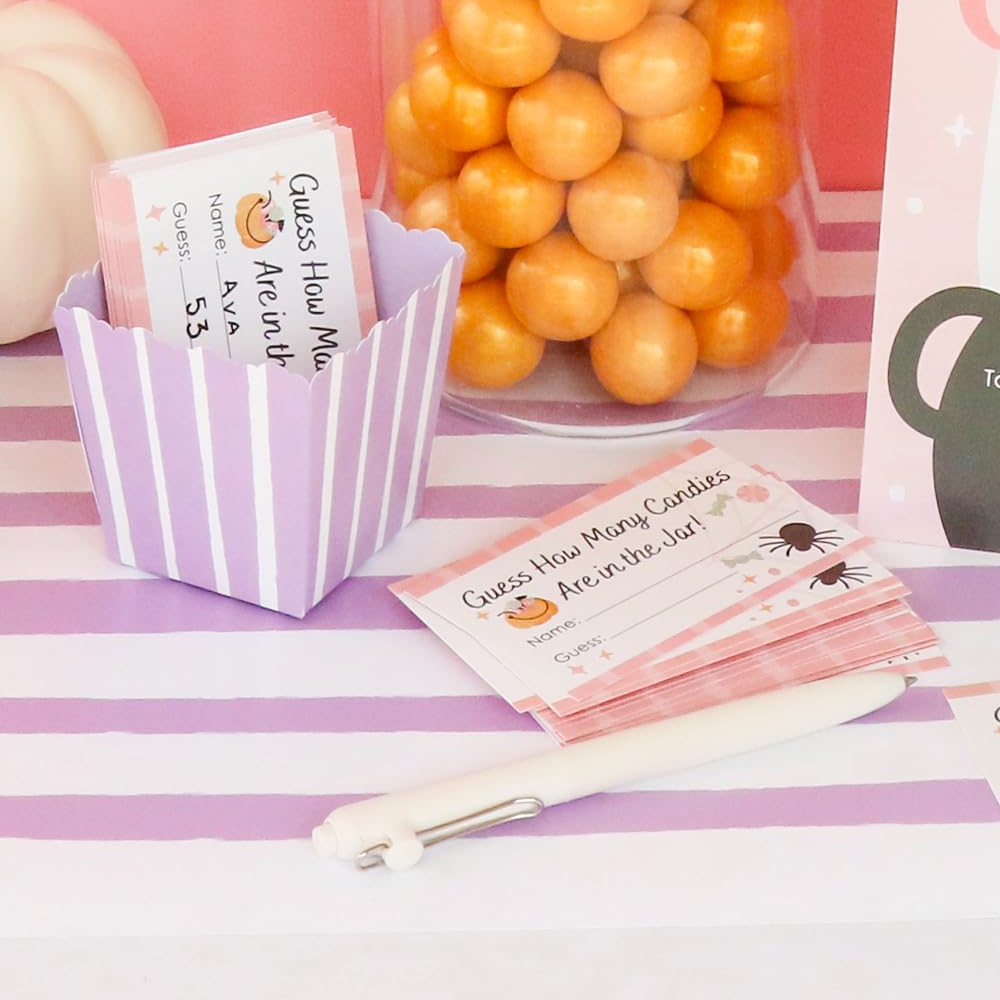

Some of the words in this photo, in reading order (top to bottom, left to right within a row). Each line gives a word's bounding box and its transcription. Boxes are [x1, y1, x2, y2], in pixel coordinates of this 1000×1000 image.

[172, 202, 191, 263] Guess:
[208, 193, 227, 256] Name:
[289, 173, 319, 251] Guess
[253, 260, 283, 306] Are
[300, 261, 329, 315] How
[186, 297, 209, 339] 53
[261, 311, 286, 340] in
[461, 571, 533, 610] Guess
[529, 543, 582, 575] How
[580, 514, 651, 549] Many
[643, 469, 731, 516] Candies
[556, 571, 600, 600] Are
[593, 562, 626, 579] in
[620, 542, 662, 566] the
[658, 514, 707, 548] Jar!
[526, 616, 582, 649] Name:
[553, 635, 607, 664] Guess:
